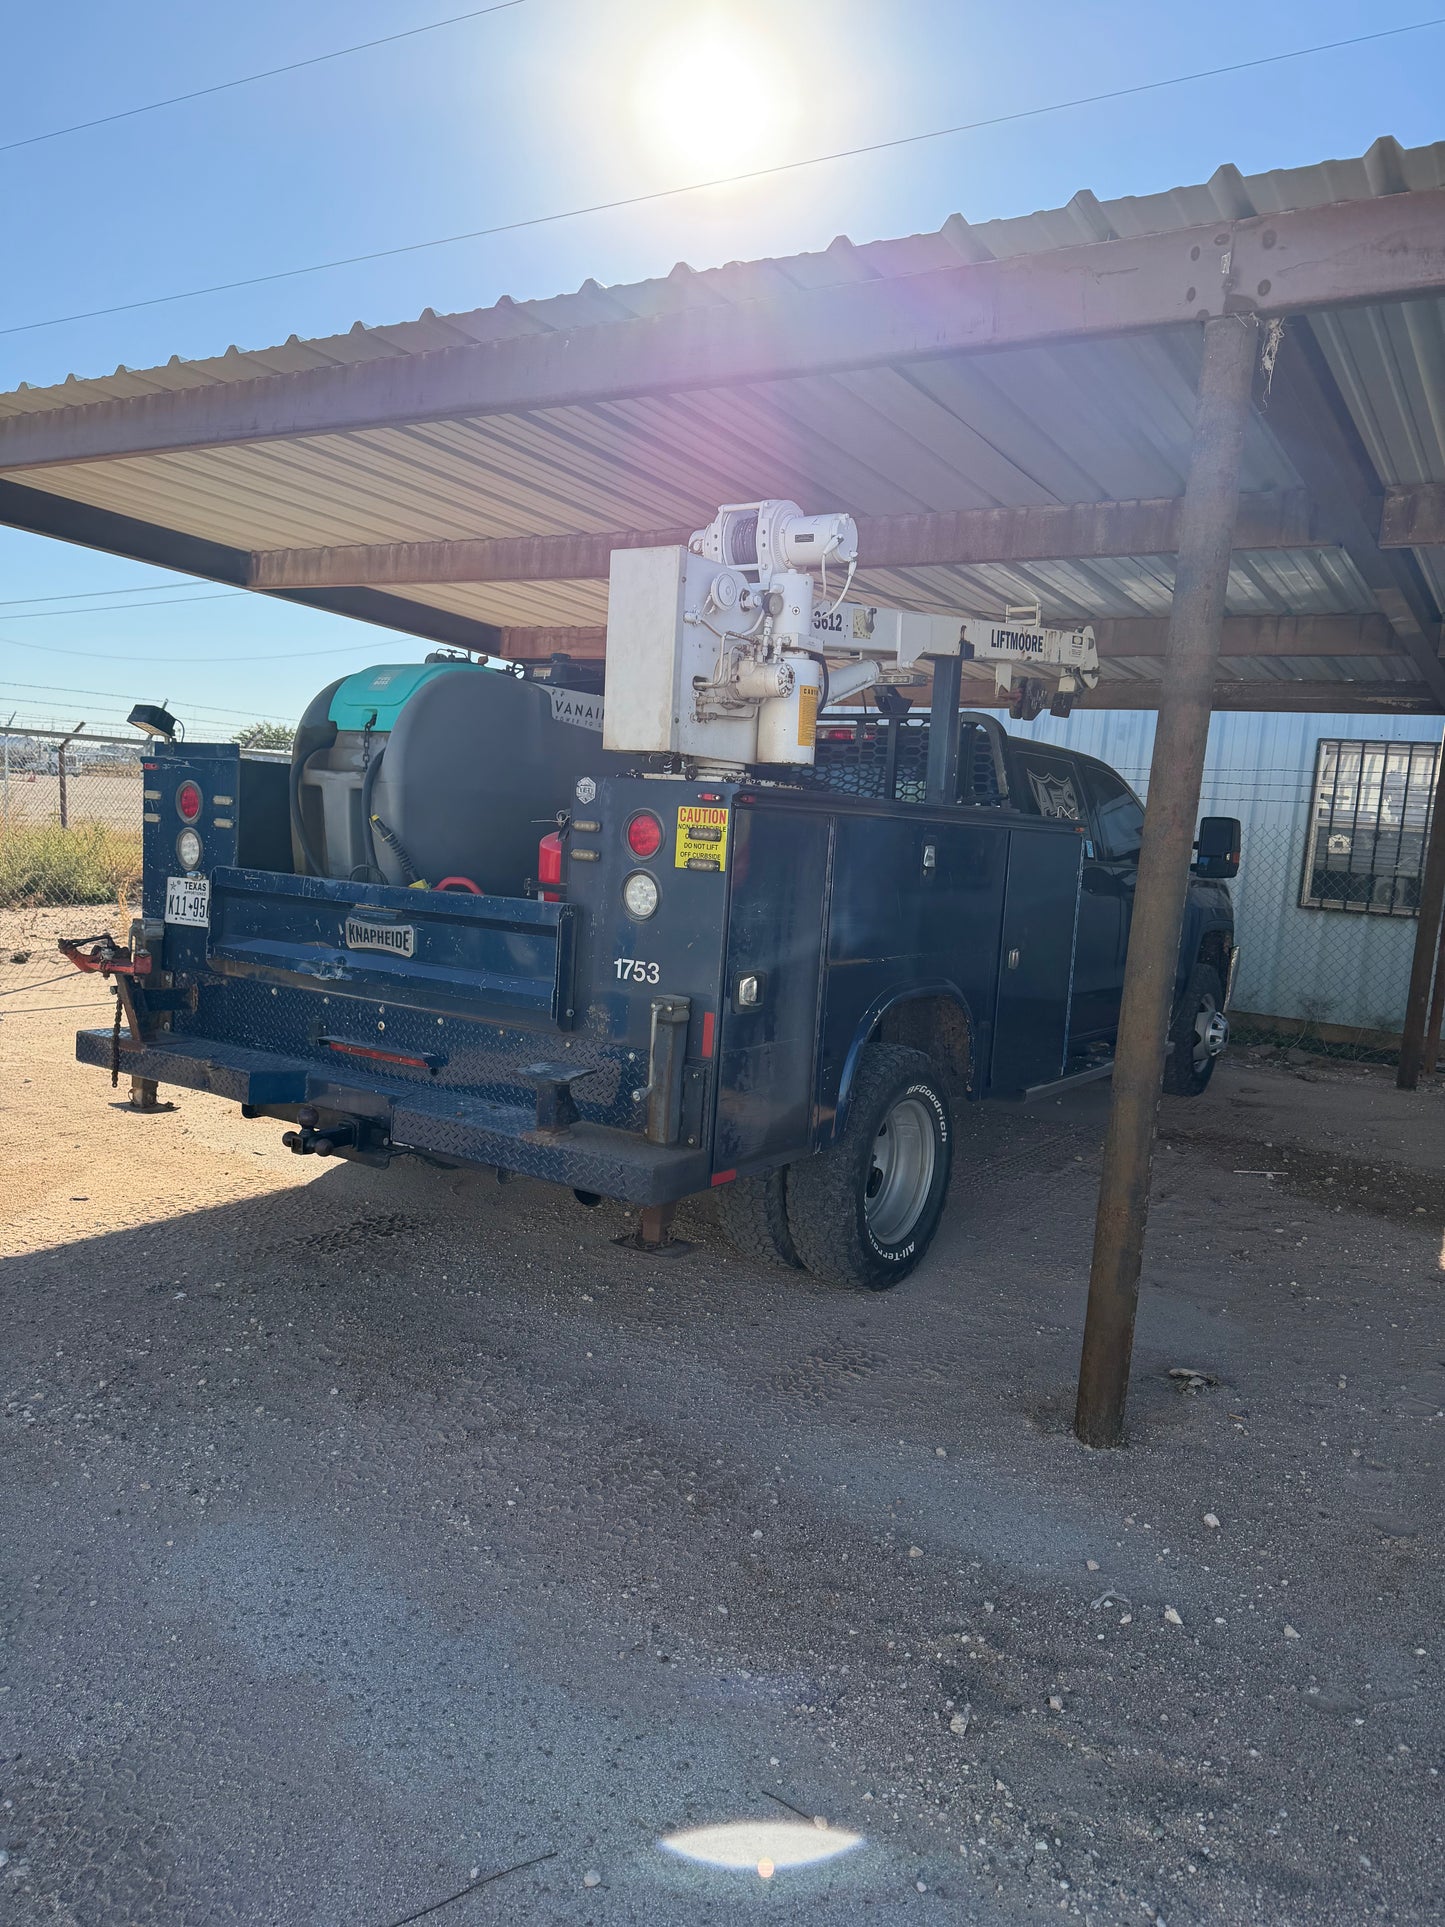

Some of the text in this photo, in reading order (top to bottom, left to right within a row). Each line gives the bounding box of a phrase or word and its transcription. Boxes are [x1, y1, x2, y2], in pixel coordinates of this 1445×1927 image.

[814, 611, 842, 631] 3612
[991, 629, 1043, 653] LIFTMOORE
[680, 808, 727, 825] CAUTION
[692, 852, 721, 860] CURBSIDE
[185, 881, 207, 891] TEXAS
[348, 922, 410, 952] KNAPHEIDE
[614, 958, 660, 984] 1753
[906, 1084, 948, 1142] BFGoodrich
